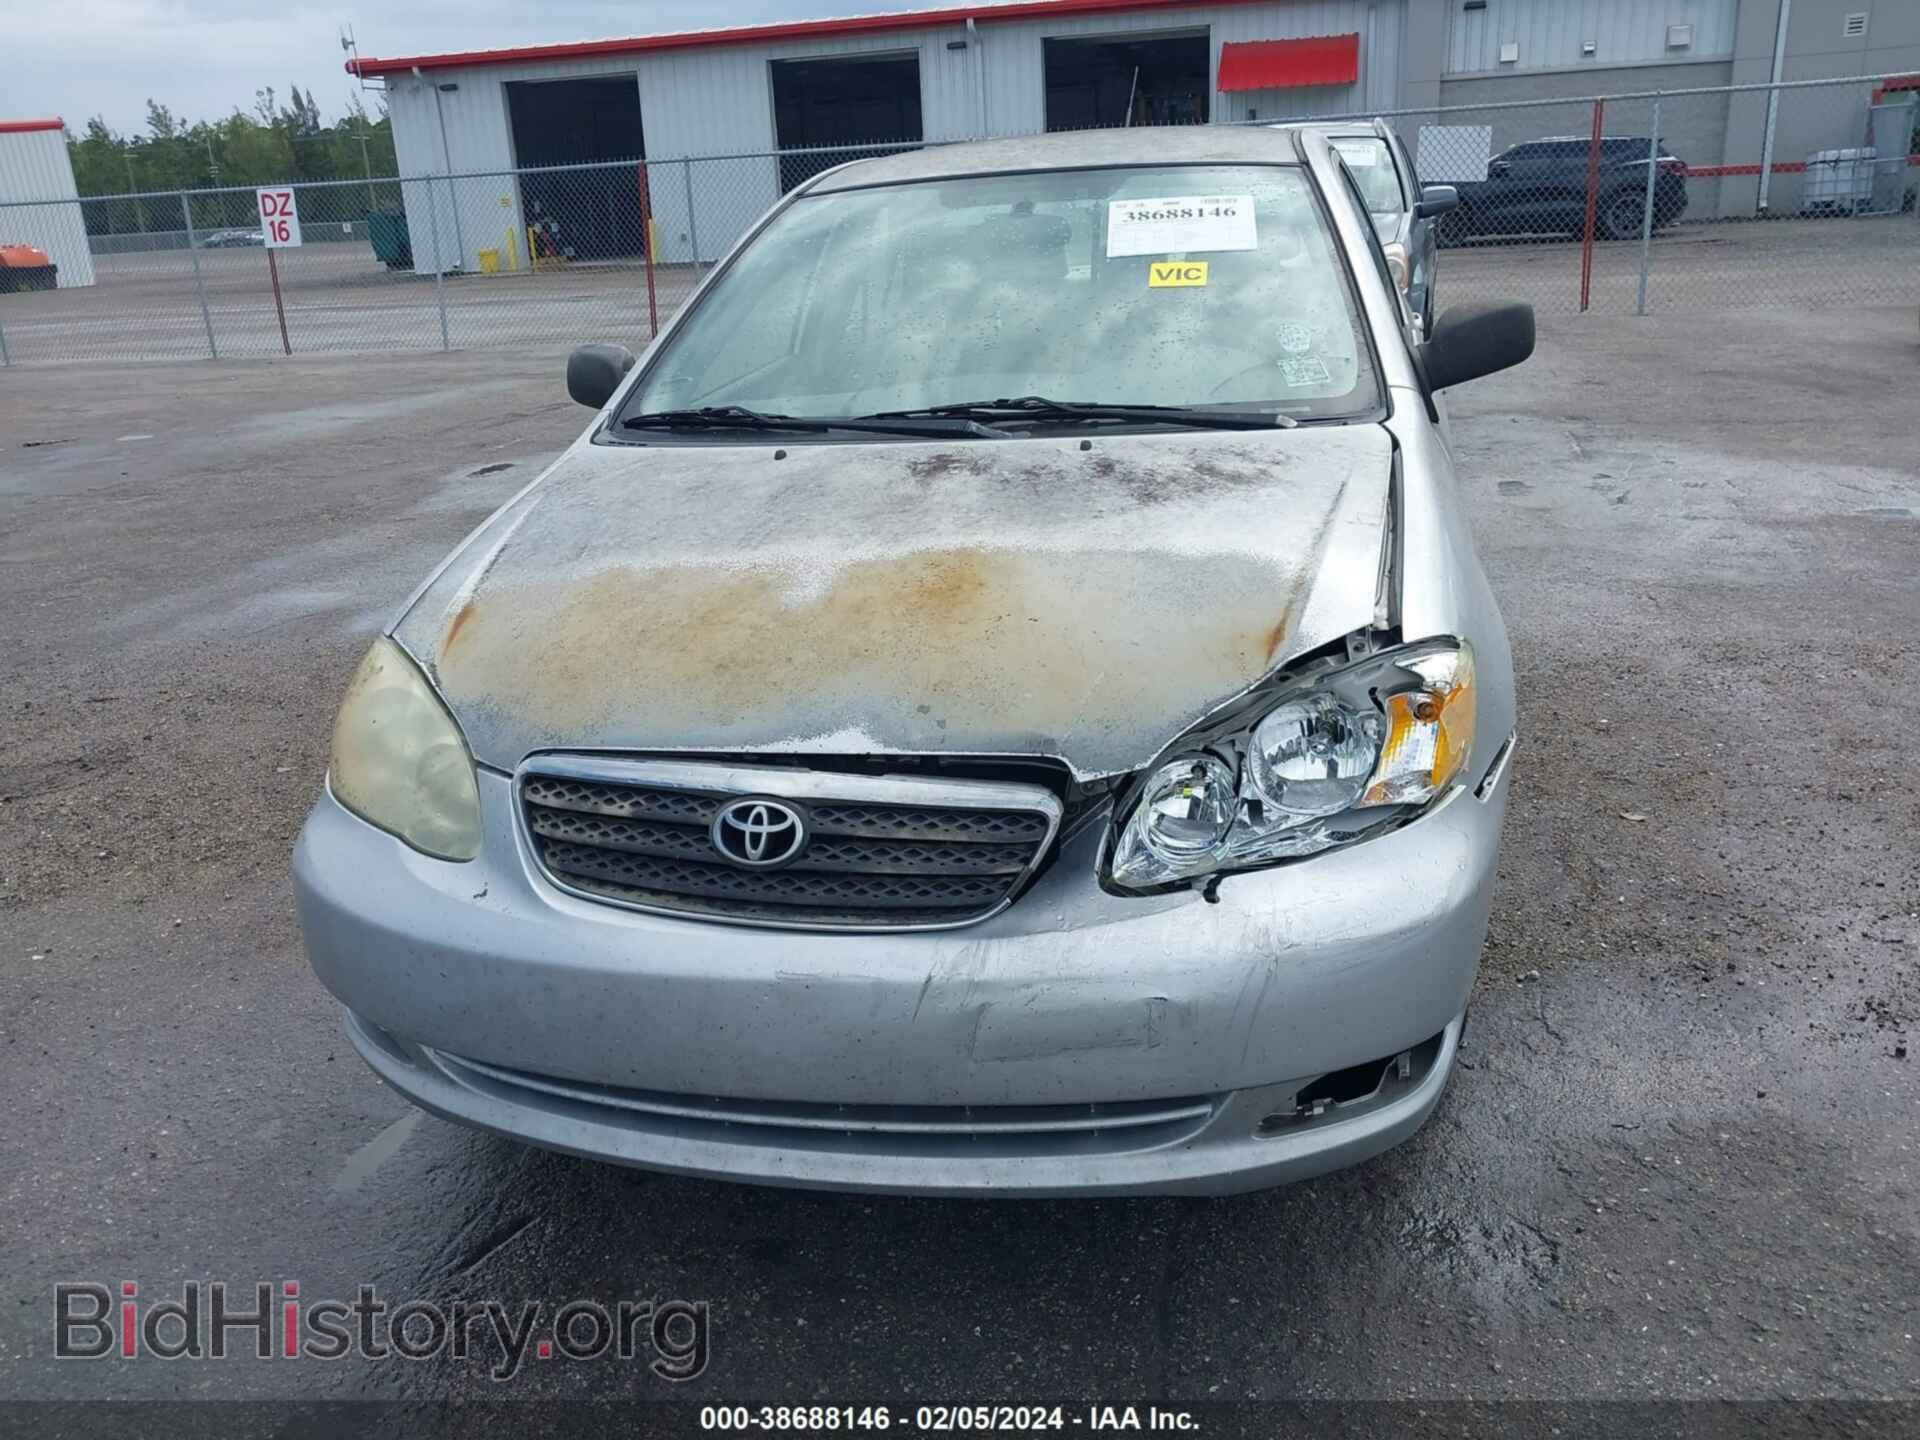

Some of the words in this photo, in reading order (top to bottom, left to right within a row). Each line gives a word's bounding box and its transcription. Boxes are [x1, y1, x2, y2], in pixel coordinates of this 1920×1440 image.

[260, 192, 293, 217] DZ
[1121, 206, 1237, 223] 38688146
[269, 219, 290, 242] 16
[1155, 267, 1202, 281] VIC
